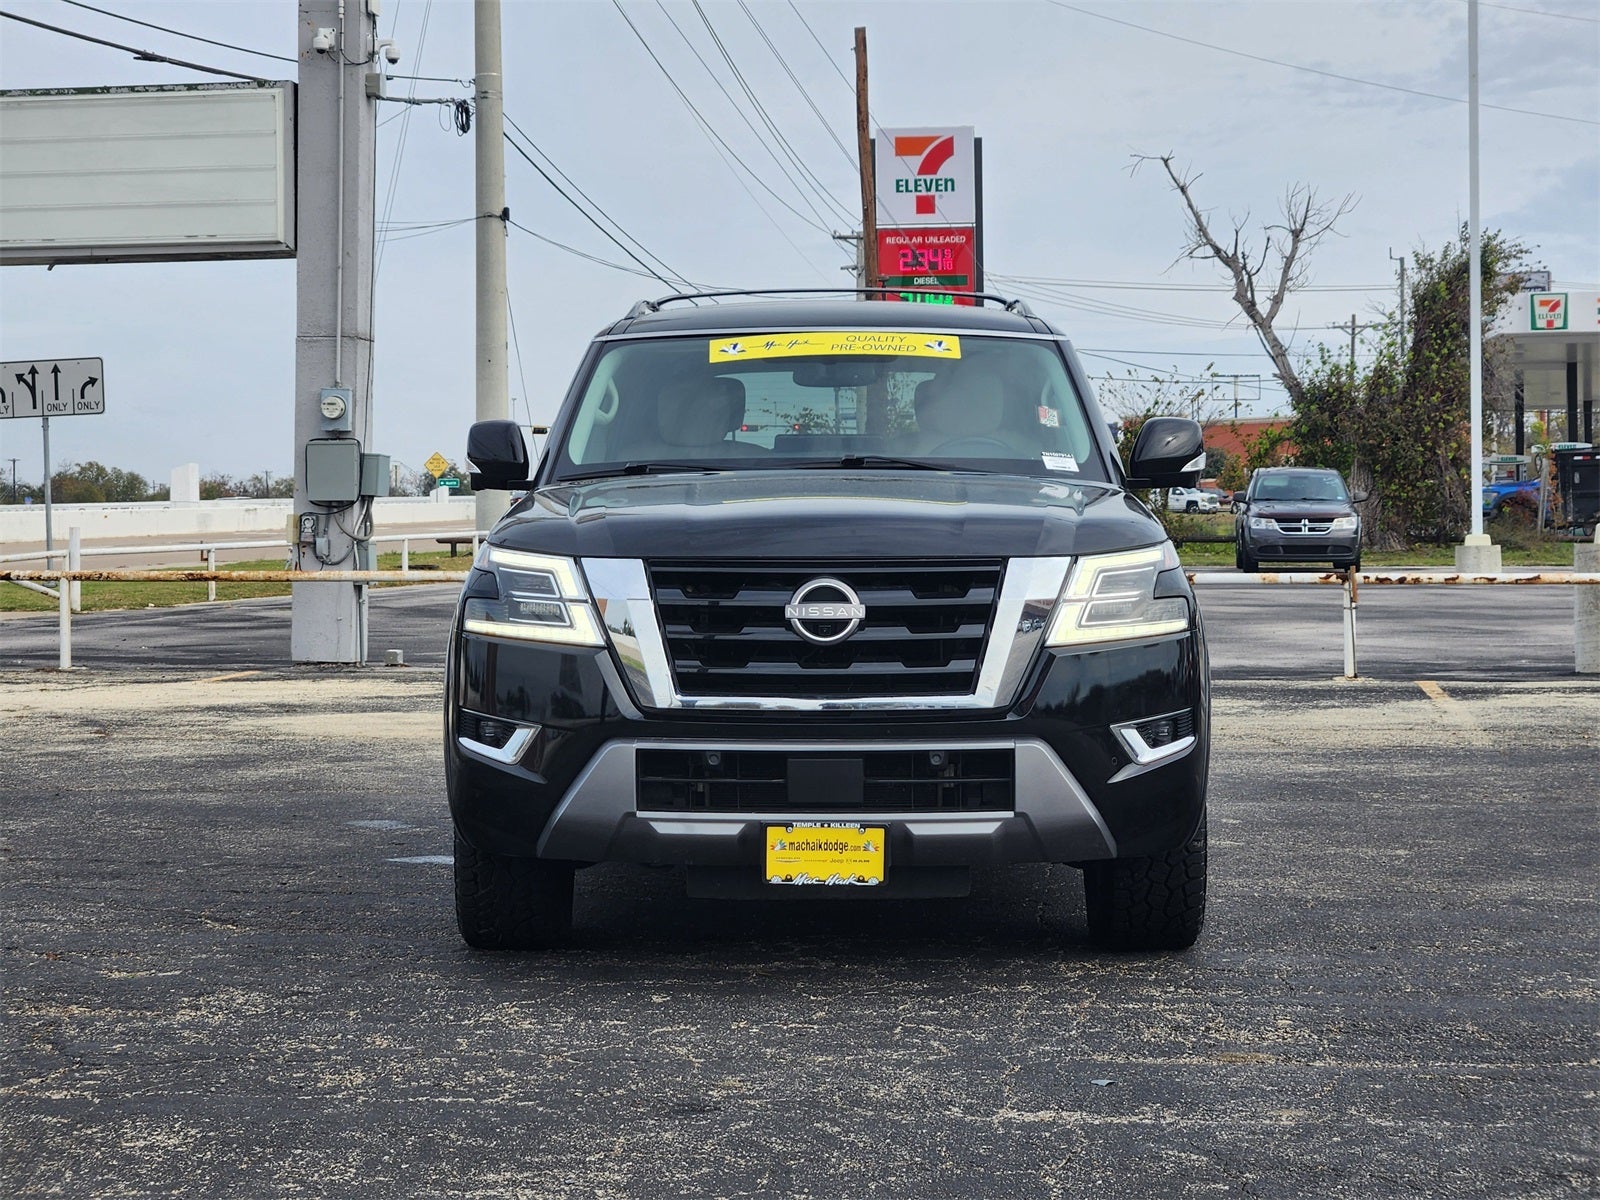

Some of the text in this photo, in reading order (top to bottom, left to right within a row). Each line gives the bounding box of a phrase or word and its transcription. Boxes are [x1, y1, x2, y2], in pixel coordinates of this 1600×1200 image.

[895, 178, 956, 193] ELEVEN
[886, 235, 966, 244] REGULAR UNLEADED
[913, 277, 939, 285] DIESEL
[845, 335, 907, 344] QUALITY
[831, 343, 917, 352] PRE-OWNED
[46, 402, 68, 412] ONLY
[77, 401, 101, 411] ONLY
[787, 607, 863, 617] NISSAN
[791, 872, 825, 886] Mac
